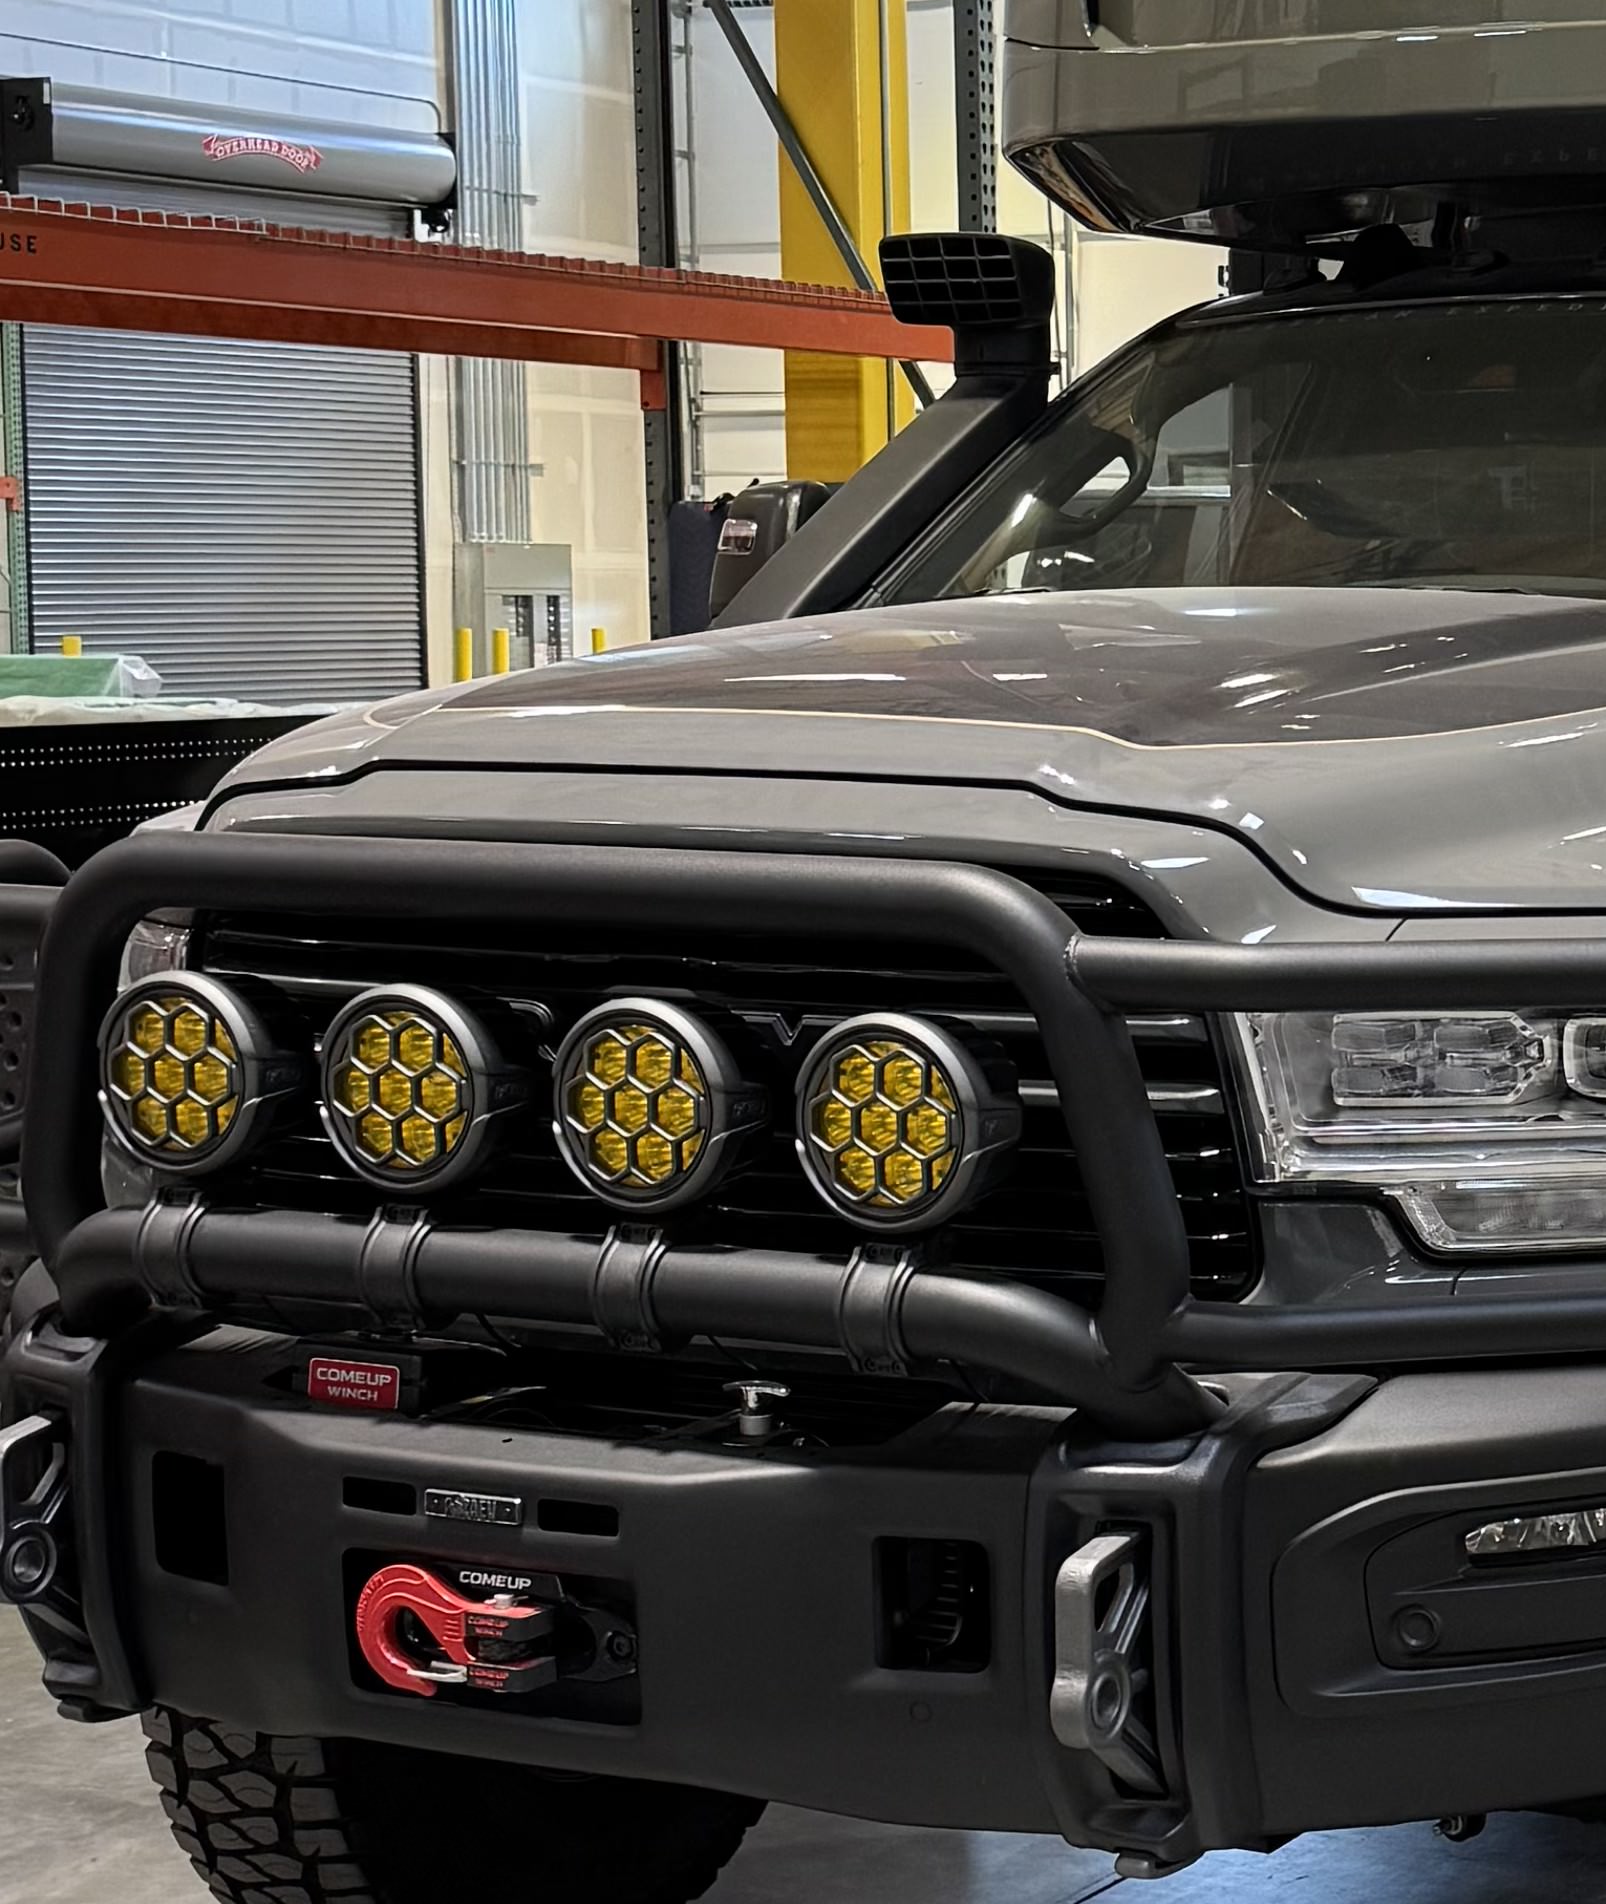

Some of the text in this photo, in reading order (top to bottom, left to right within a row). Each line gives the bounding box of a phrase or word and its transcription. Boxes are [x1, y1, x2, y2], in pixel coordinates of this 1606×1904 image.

[215, 138, 279, 157] OVERHEAD
[316, 1366, 392, 1386] COMEUP
[327, 1385, 378, 1401] WINCH
[459, 1570, 532, 1590] COMEUP
